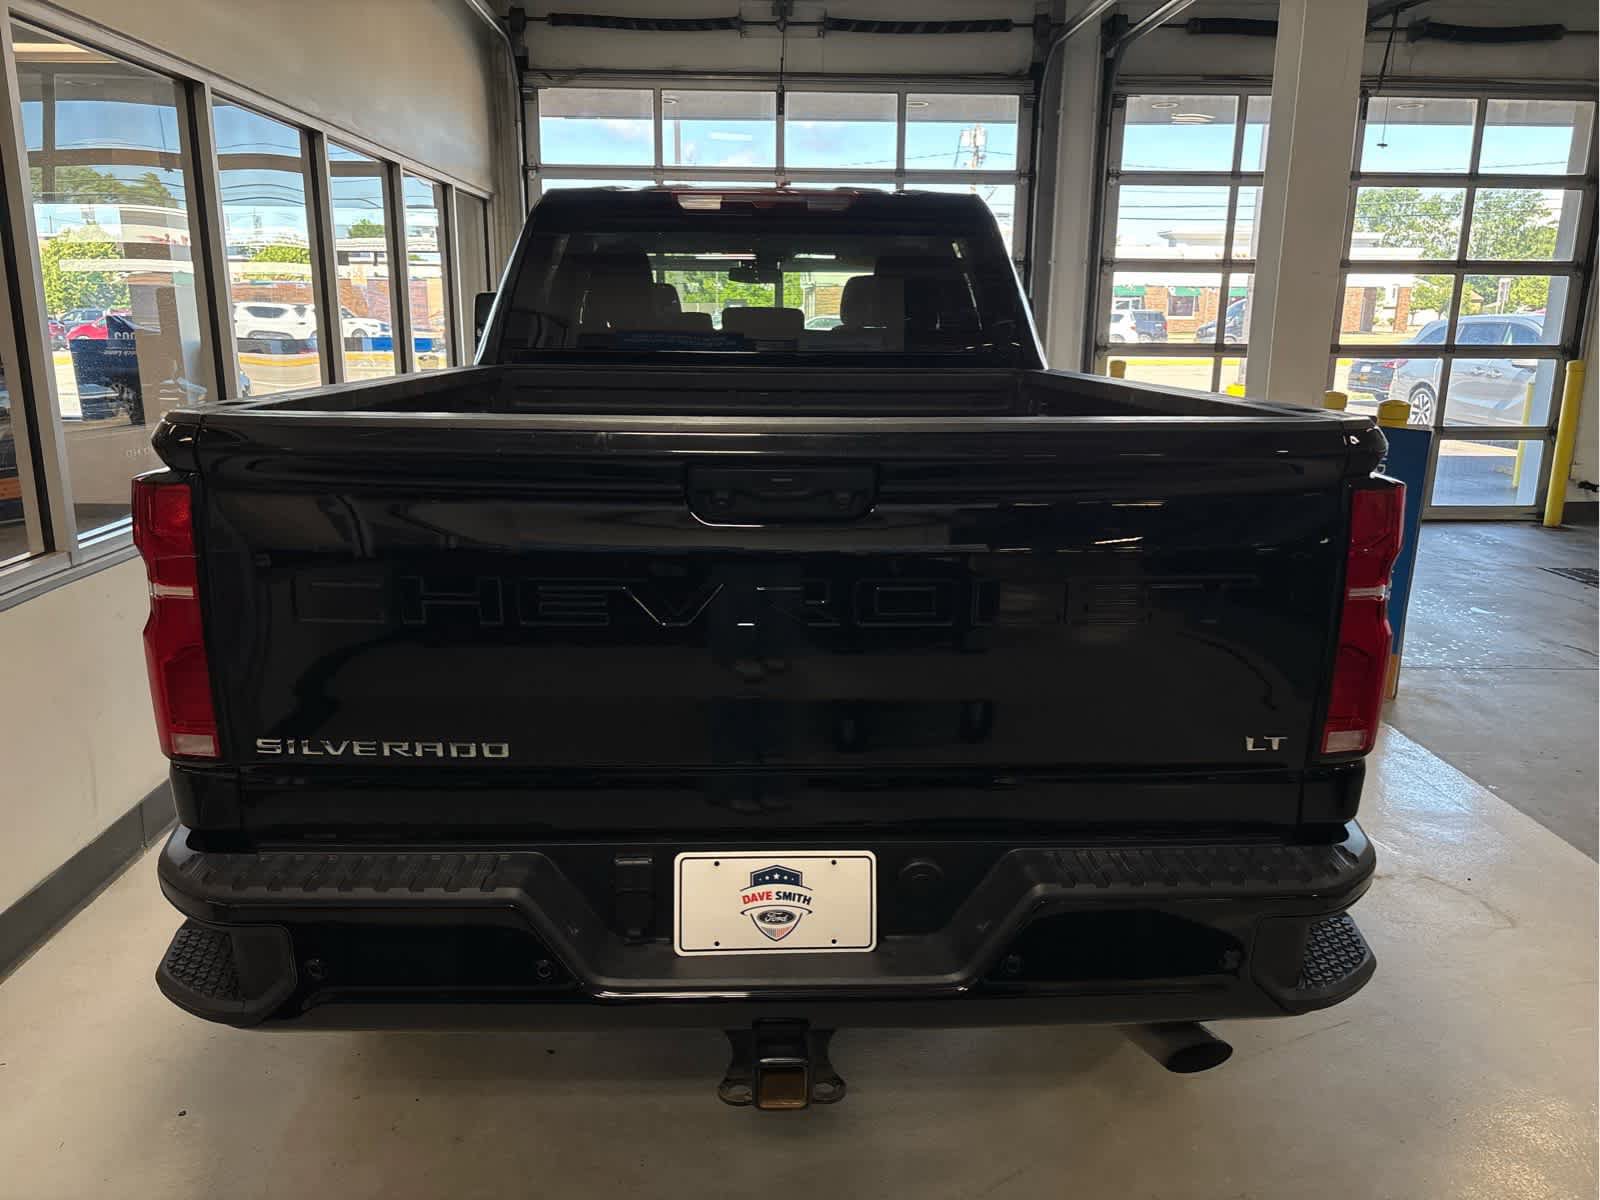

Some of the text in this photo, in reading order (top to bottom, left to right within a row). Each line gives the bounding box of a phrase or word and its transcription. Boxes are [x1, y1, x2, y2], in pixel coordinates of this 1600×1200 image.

[255, 737, 510, 759] SILVERADO
[1245, 735, 1288, 751] LT
[742, 891, 812, 905] DAVE SMITH
[764, 911, 789, 922] Ford
